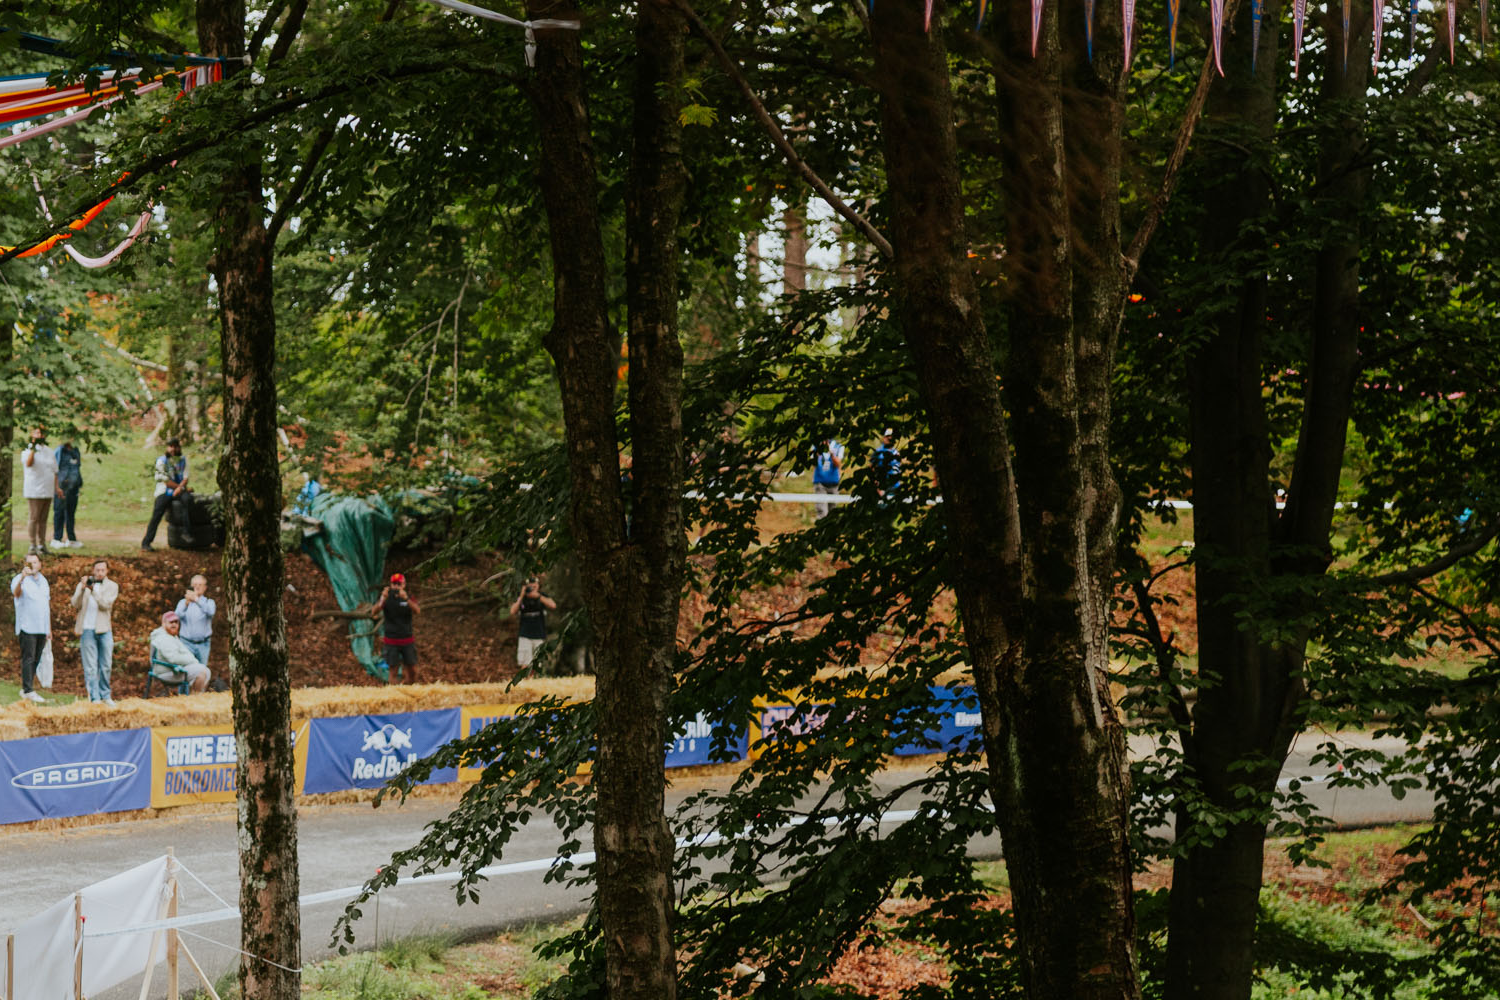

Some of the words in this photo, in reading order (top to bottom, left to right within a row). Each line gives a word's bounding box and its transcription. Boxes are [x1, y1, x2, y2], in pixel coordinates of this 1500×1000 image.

[167, 736, 214, 767] RACE
[32, 764, 117, 786] PAGANI
[352, 755, 387, 780] Red
[164, 768, 237, 796] BORROMEO
